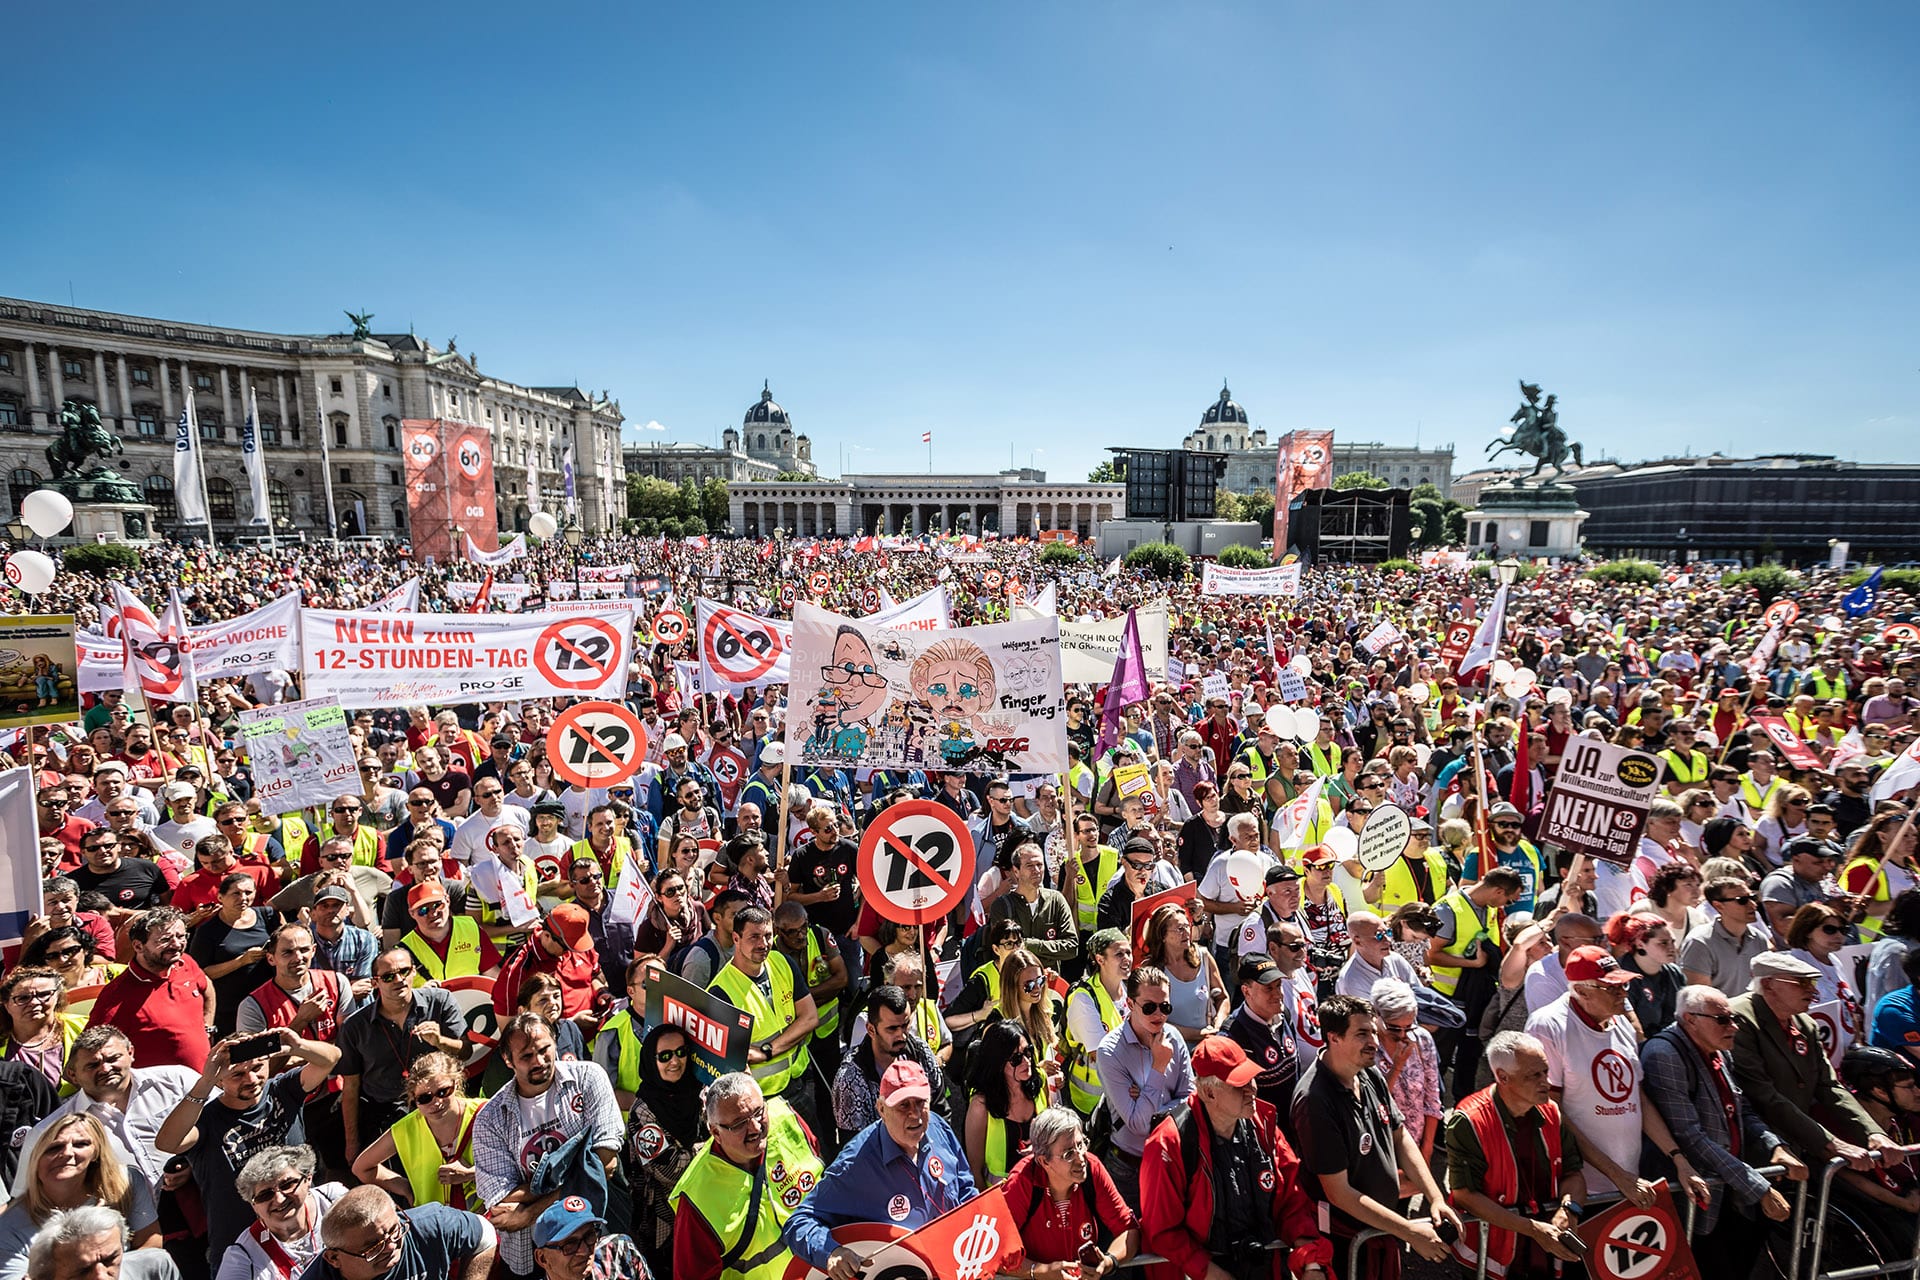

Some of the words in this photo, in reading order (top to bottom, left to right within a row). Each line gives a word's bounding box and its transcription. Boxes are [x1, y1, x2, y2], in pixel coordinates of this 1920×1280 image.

[461, 449, 481, 467] 60
[814, 577, 827, 587] 12
[783, 590, 795, 602] 12
[865, 594, 877, 607] 12
[335, 618, 414, 644] NEIN
[423, 630, 475, 644] zum
[658, 621, 683, 635] 60
[716, 628, 772, 660] 60
[1453, 630, 1469, 644] 12
[314, 647, 528, 670] 12-STUNDEN-TAG
[553, 636, 610, 671] 12
[1000, 694, 1047, 712] Finger
[1029, 706, 1056, 720] weg
[568, 726, 630, 764] 12
[986, 737, 1030, 753] AZG
[324, 763, 356, 779] vida
[1564, 744, 1602, 779] JA
[1599, 772, 1615, 783] zur
[257, 777, 293, 794] vida
[1560, 773, 1651, 804] Willkommenskultur!
[1142, 795, 1153, 804] 12
[1550, 794, 1615, 837] NEIN
[1619, 812, 1633, 828] 12
[1548, 822, 1629, 855] 12-Stunden-Tag!
[1609, 828, 1632, 842] zum
[840, 865, 847, 873] 12
[884, 831, 955, 893] 12
[454, 941, 472, 952] vida
[667, 1001, 724, 1052] NEIN
[1602, 1061, 1625, 1094] 12
[931, 1160, 942, 1174] 12
[799, 1175, 813, 1189] 12
[786, 1190, 799, 1205] 12
[1610, 1220, 1661, 1275] 12
